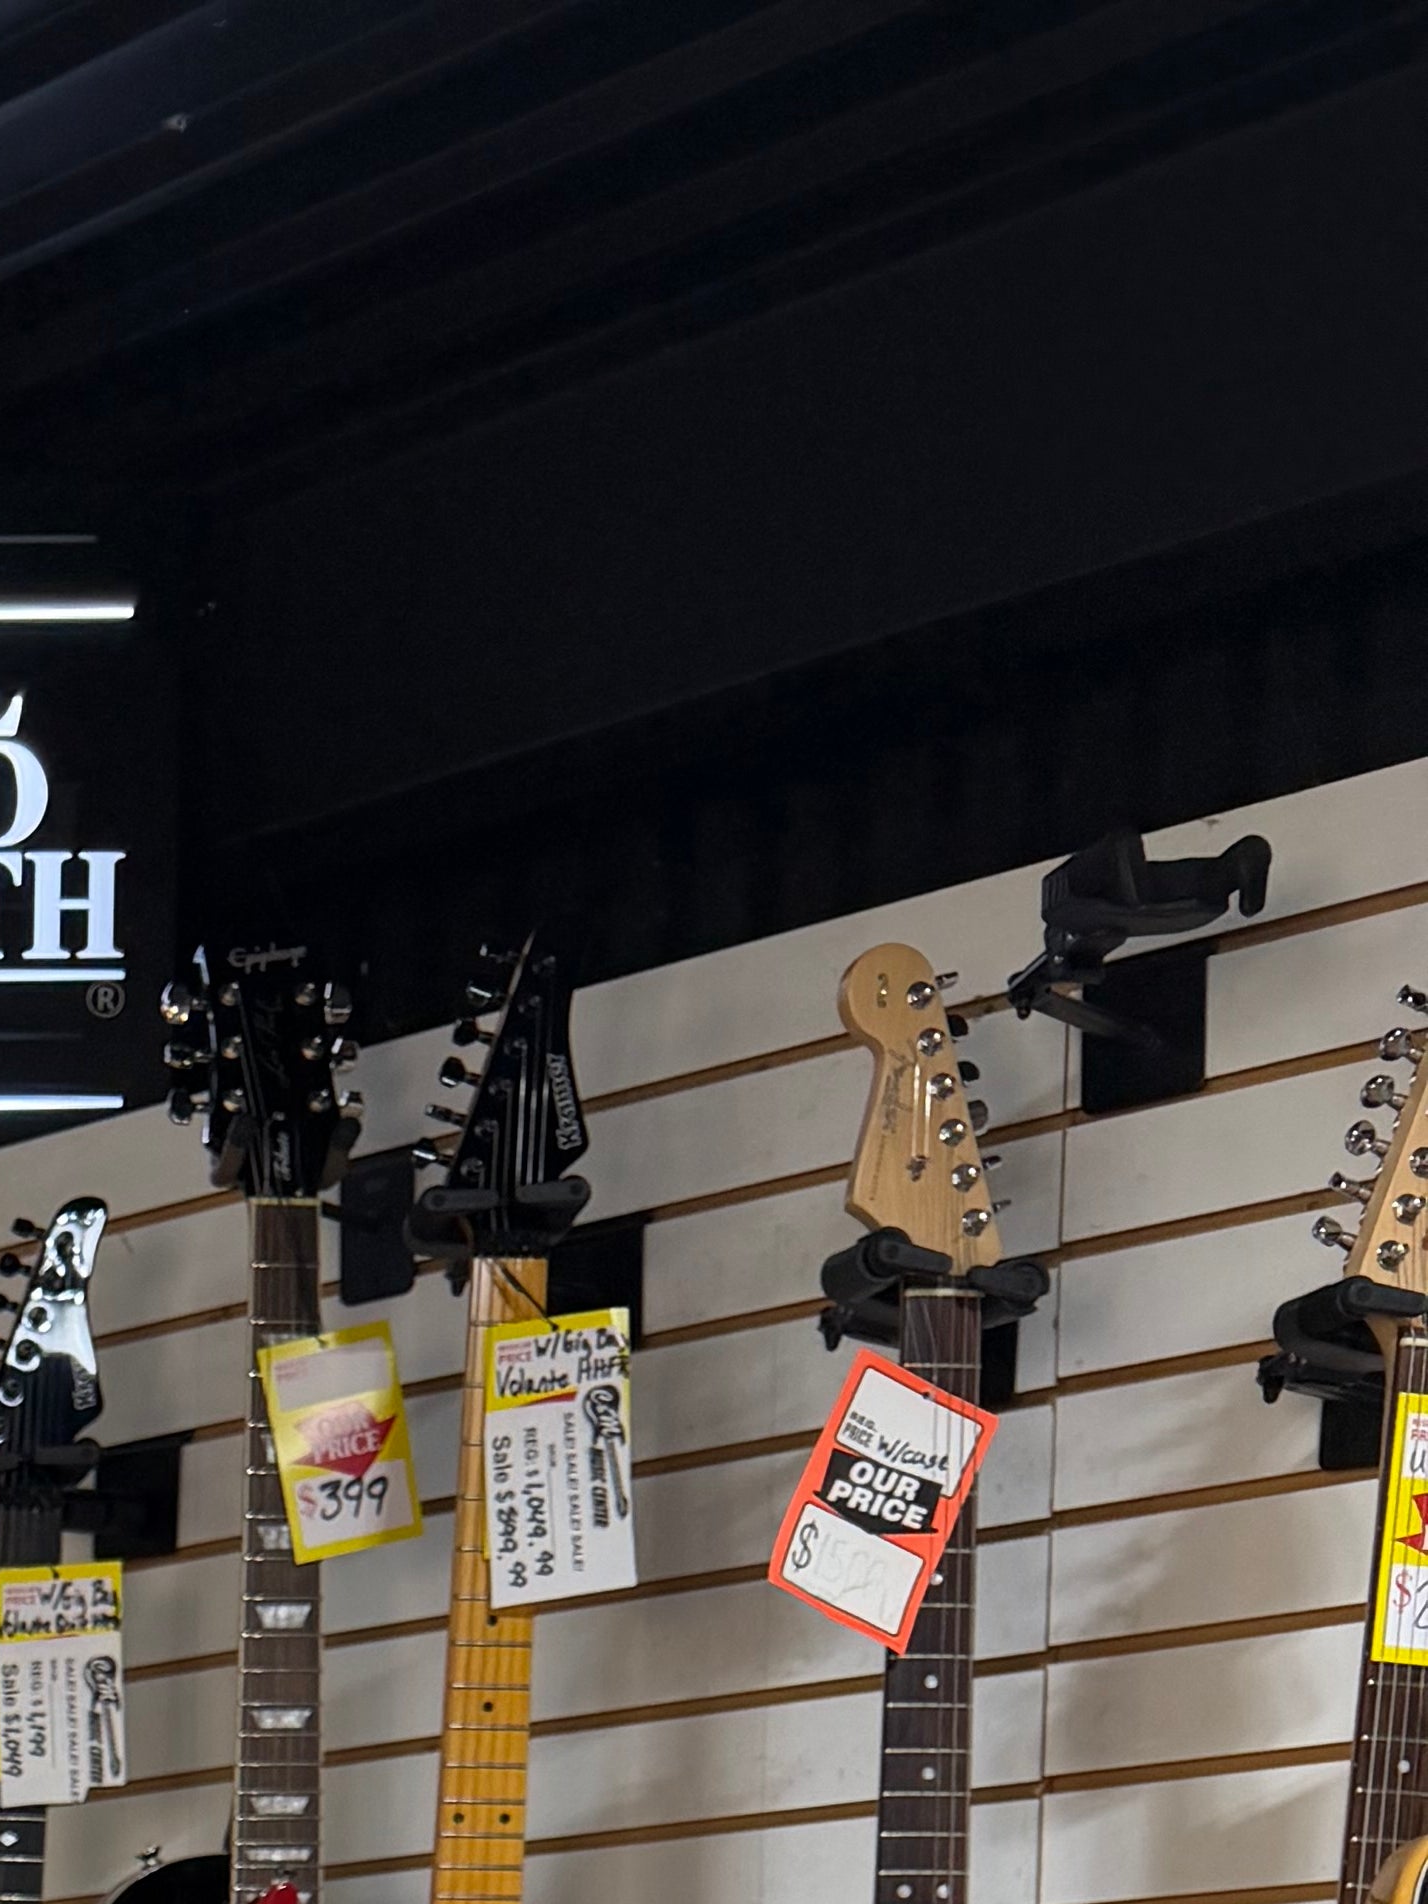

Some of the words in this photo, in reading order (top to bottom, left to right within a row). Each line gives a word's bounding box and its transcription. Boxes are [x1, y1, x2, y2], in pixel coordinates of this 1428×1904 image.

[311, 1430, 381, 1464] PRICE
[843, 1422, 875, 1448] PRICE
[849, 1461, 921, 1501] OUR
[826, 1479, 929, 1530] PRICE
